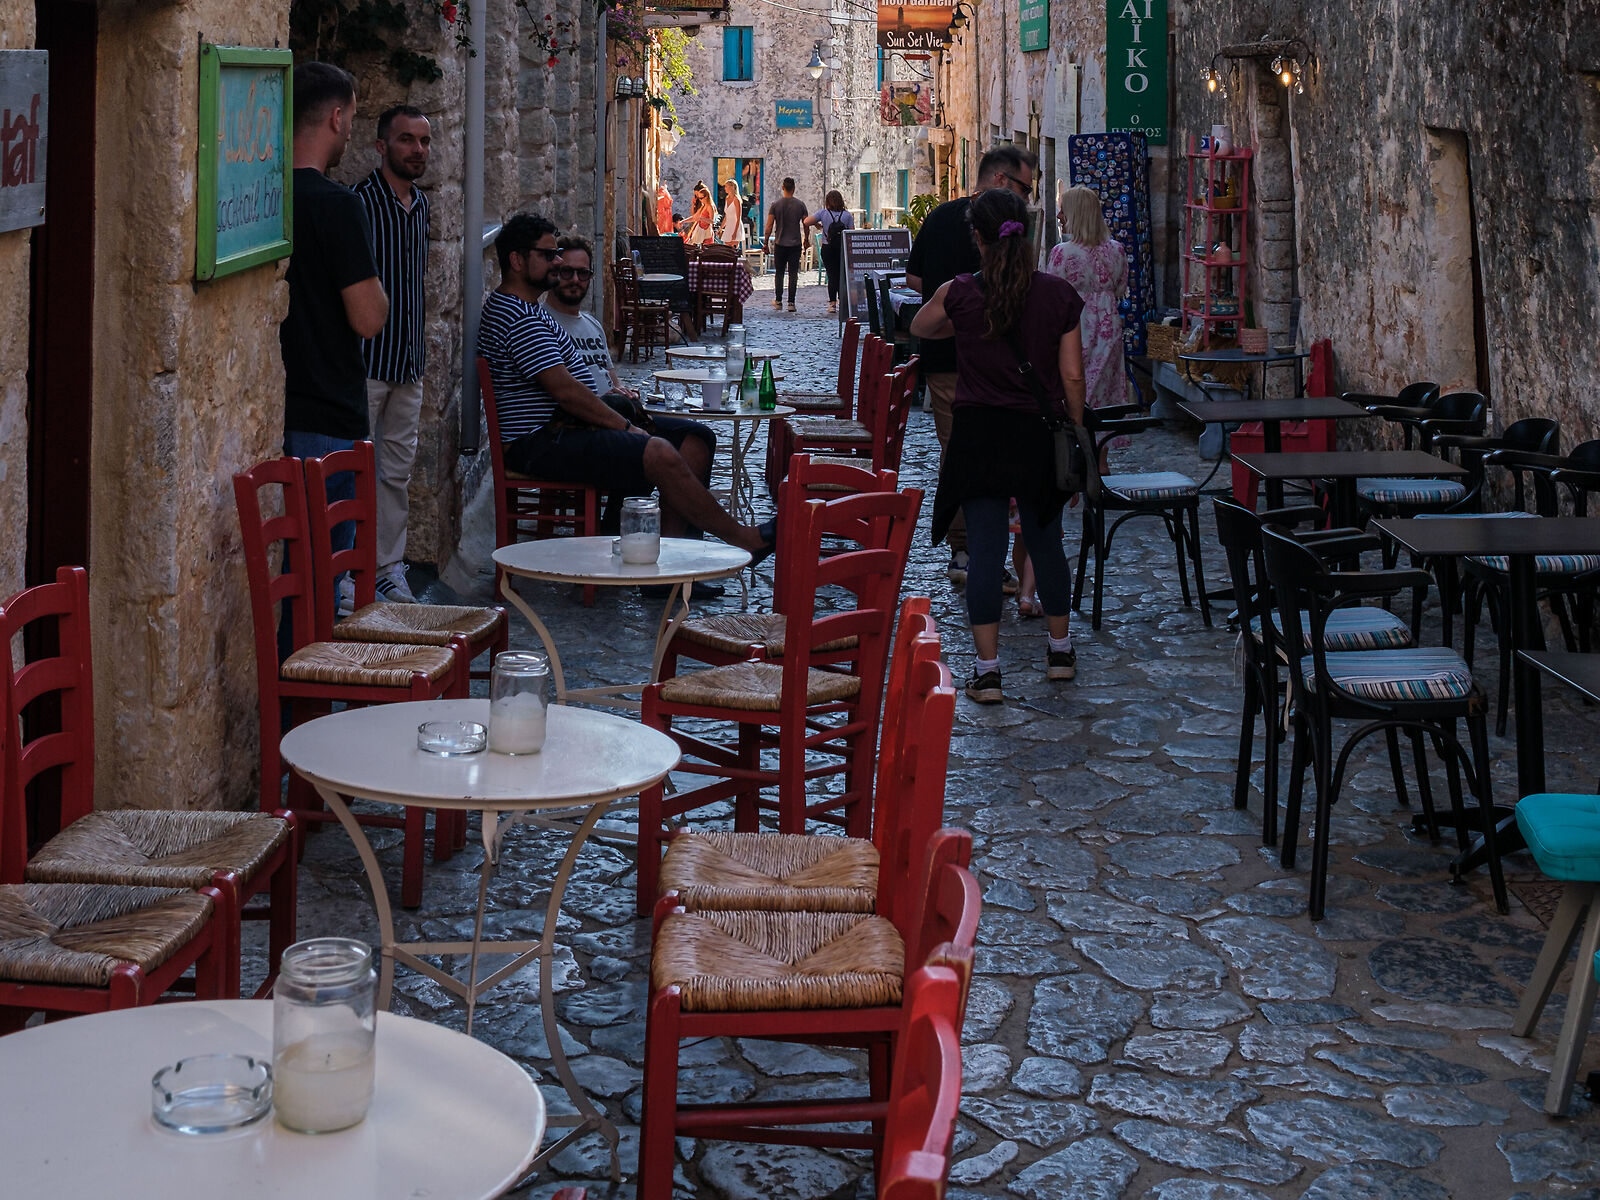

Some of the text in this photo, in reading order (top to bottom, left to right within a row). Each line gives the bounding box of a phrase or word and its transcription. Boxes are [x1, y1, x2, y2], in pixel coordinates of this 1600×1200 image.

[886, 31, 943, 48] Sun Set Vie
[263, 174, 282, 219] bar
